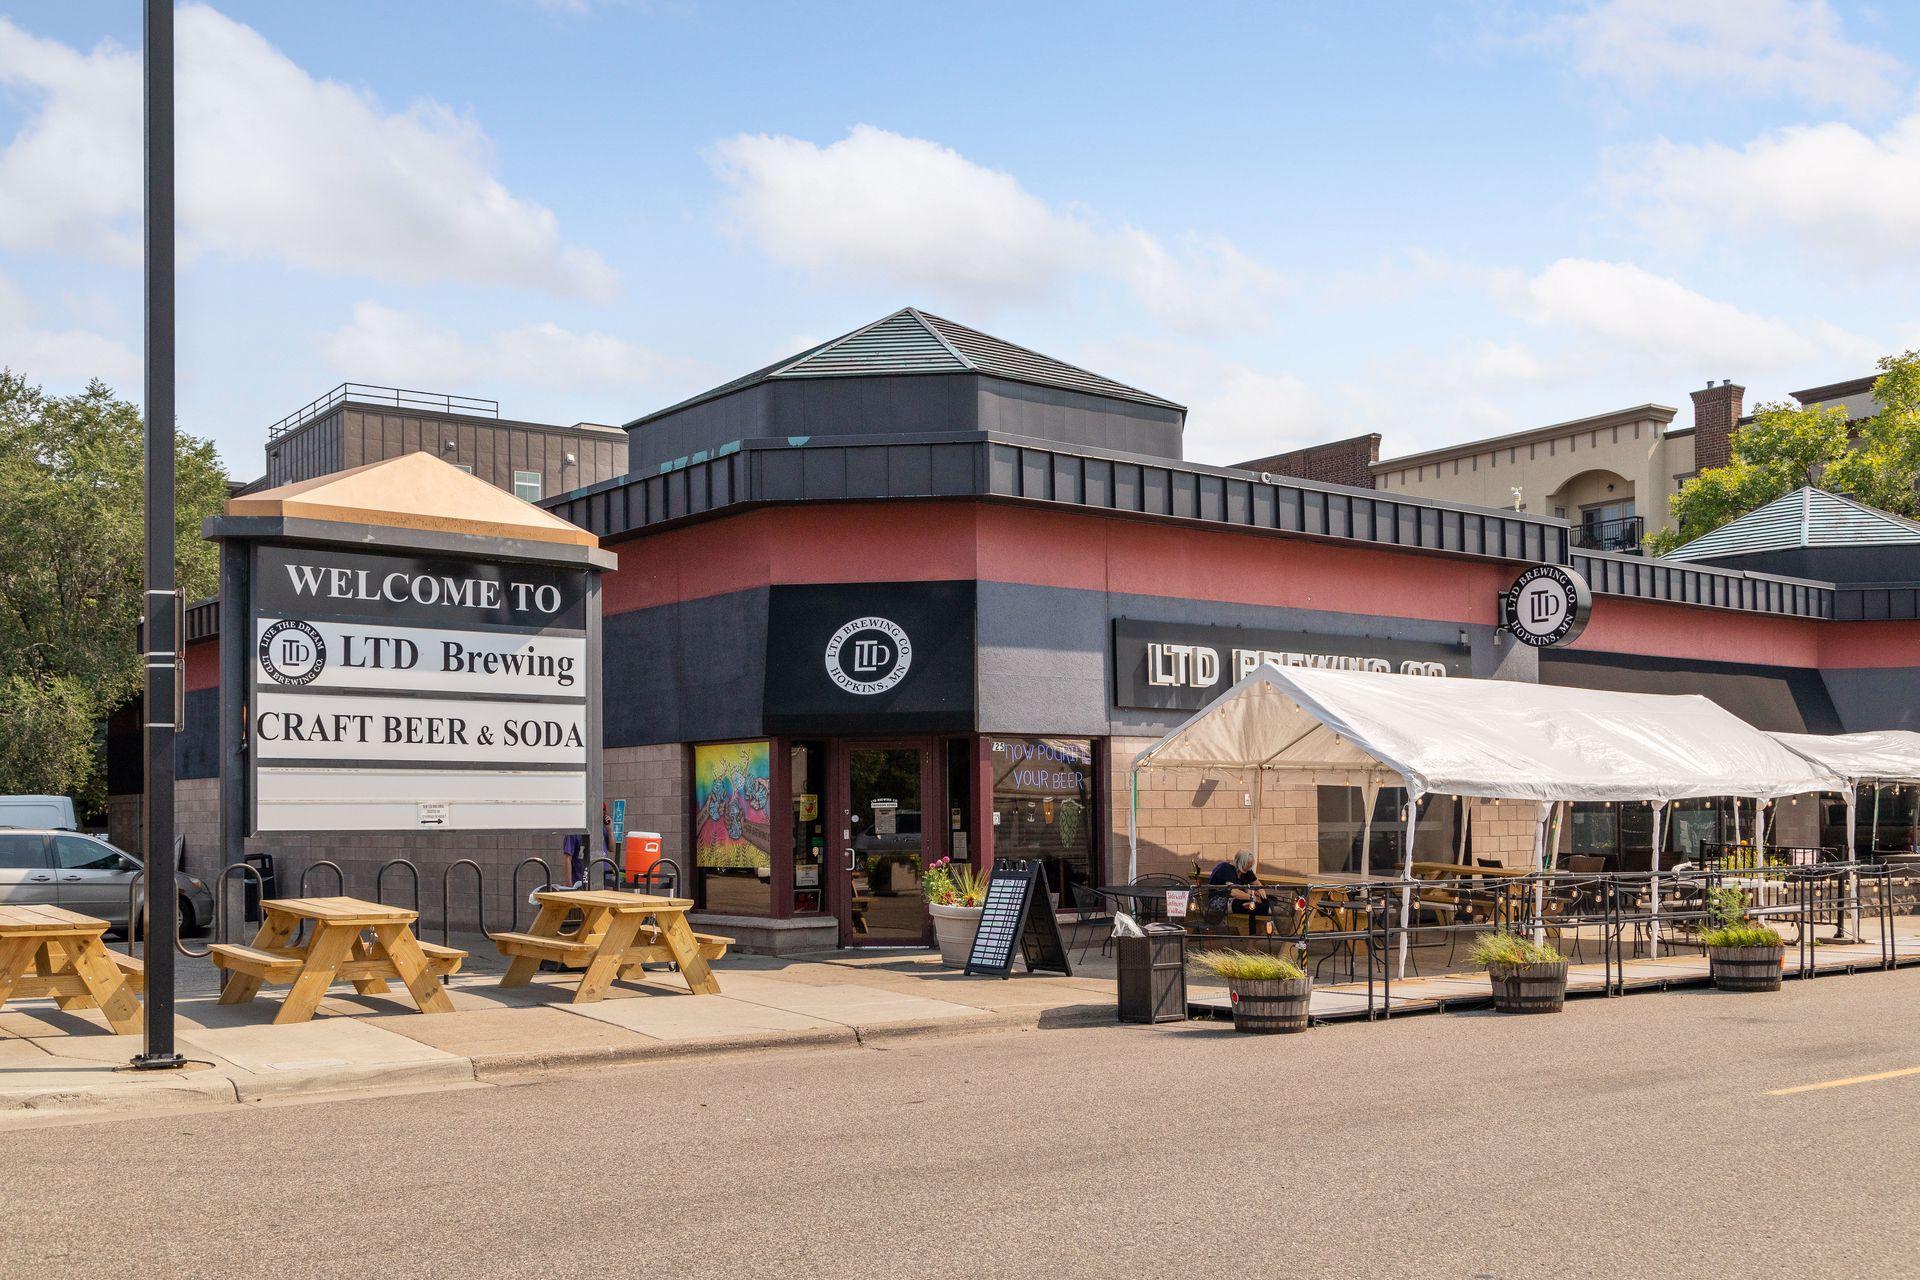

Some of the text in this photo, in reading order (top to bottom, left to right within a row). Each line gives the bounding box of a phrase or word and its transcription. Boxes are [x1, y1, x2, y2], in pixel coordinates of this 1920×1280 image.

[285, 564, 562, 613] WELCOME TO
[1508, 587, 1520, 611] LTD
[1520, 567, 1568, 585] BREWING
[261, 621, 324, 650] LIVE THE DREAM
[828, 635, 843, 658] LTD
[843, 619, 901, 636] BREWING
[1511, 613, 1573, 645] HOPKINS, MN
[262, 655, 274, 673] LTD
[272, 672, 316, 685] BREWING
[340, 635, 575, 686] LTD Brewing
[831, 665, 906, 692] HOPKINS, MN
[1148, 643, 1220, 687] LTD
[257, 711, 584, 748] CRAFT BEER & SODA
[1013, 770, 1084, 790] YOUR BEER
